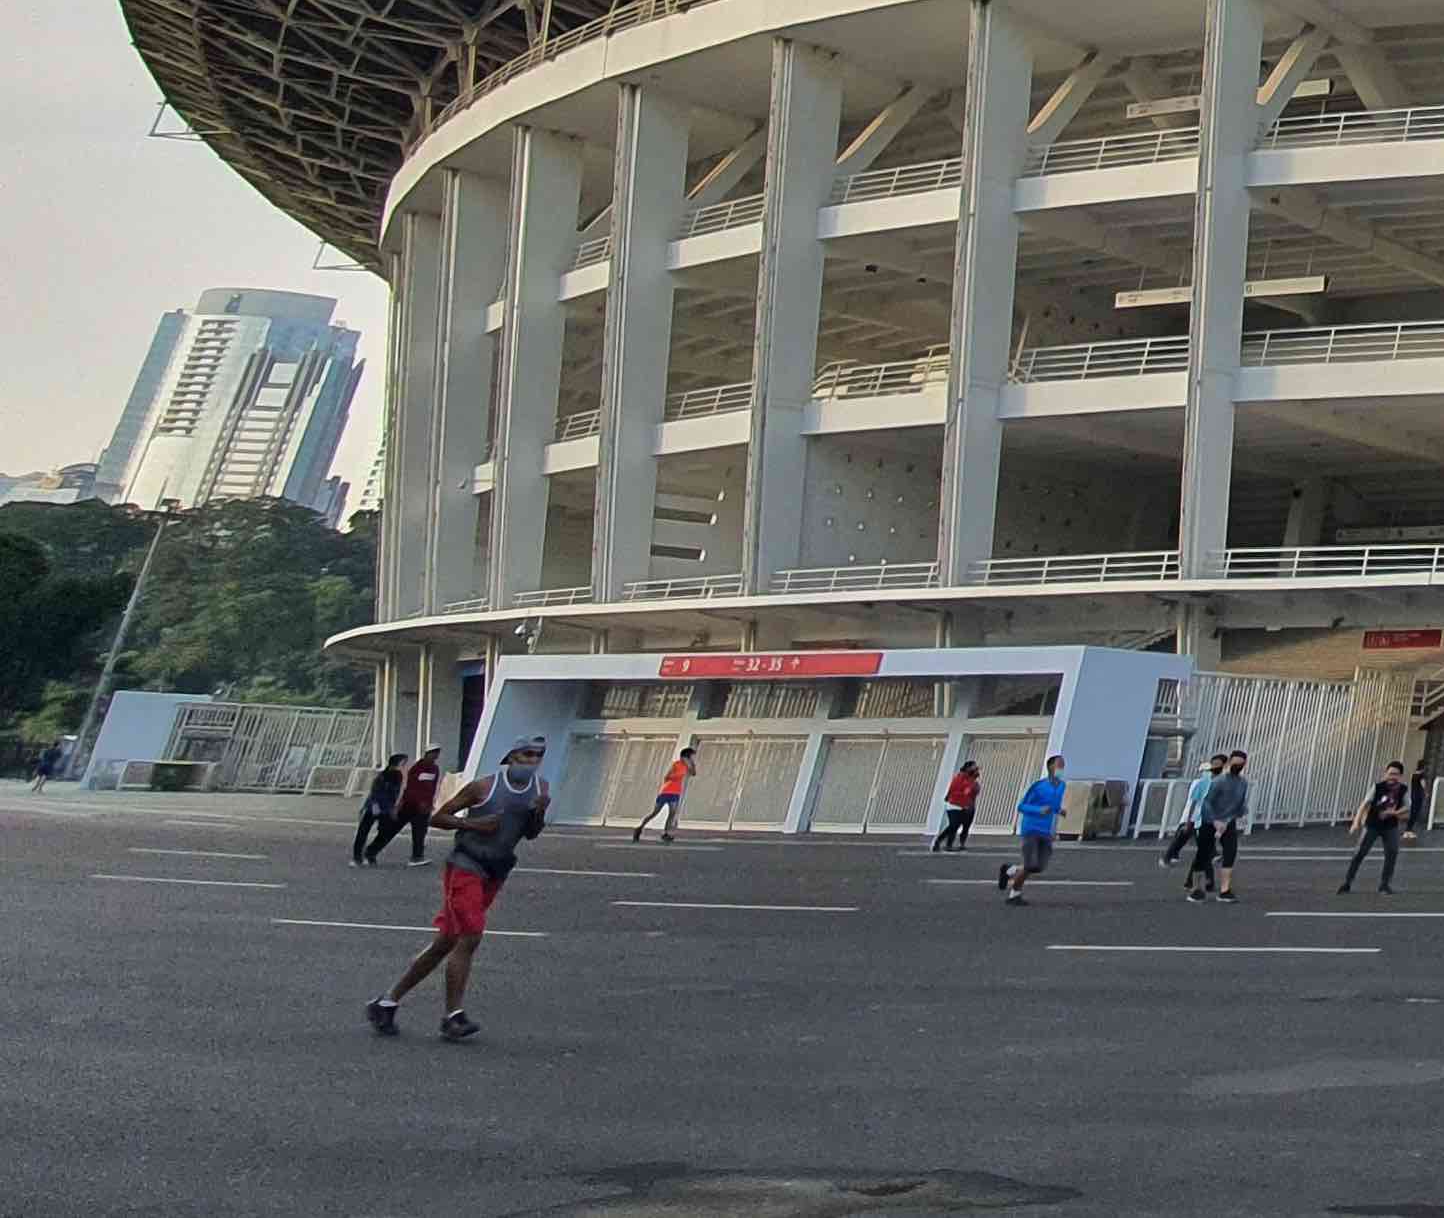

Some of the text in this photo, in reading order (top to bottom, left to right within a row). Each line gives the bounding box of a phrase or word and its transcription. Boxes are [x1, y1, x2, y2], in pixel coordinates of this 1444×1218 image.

[681, 658, 690, 672] 9
[745, 657, 760, 672] 32
[768, 656, 783, 671] 35
